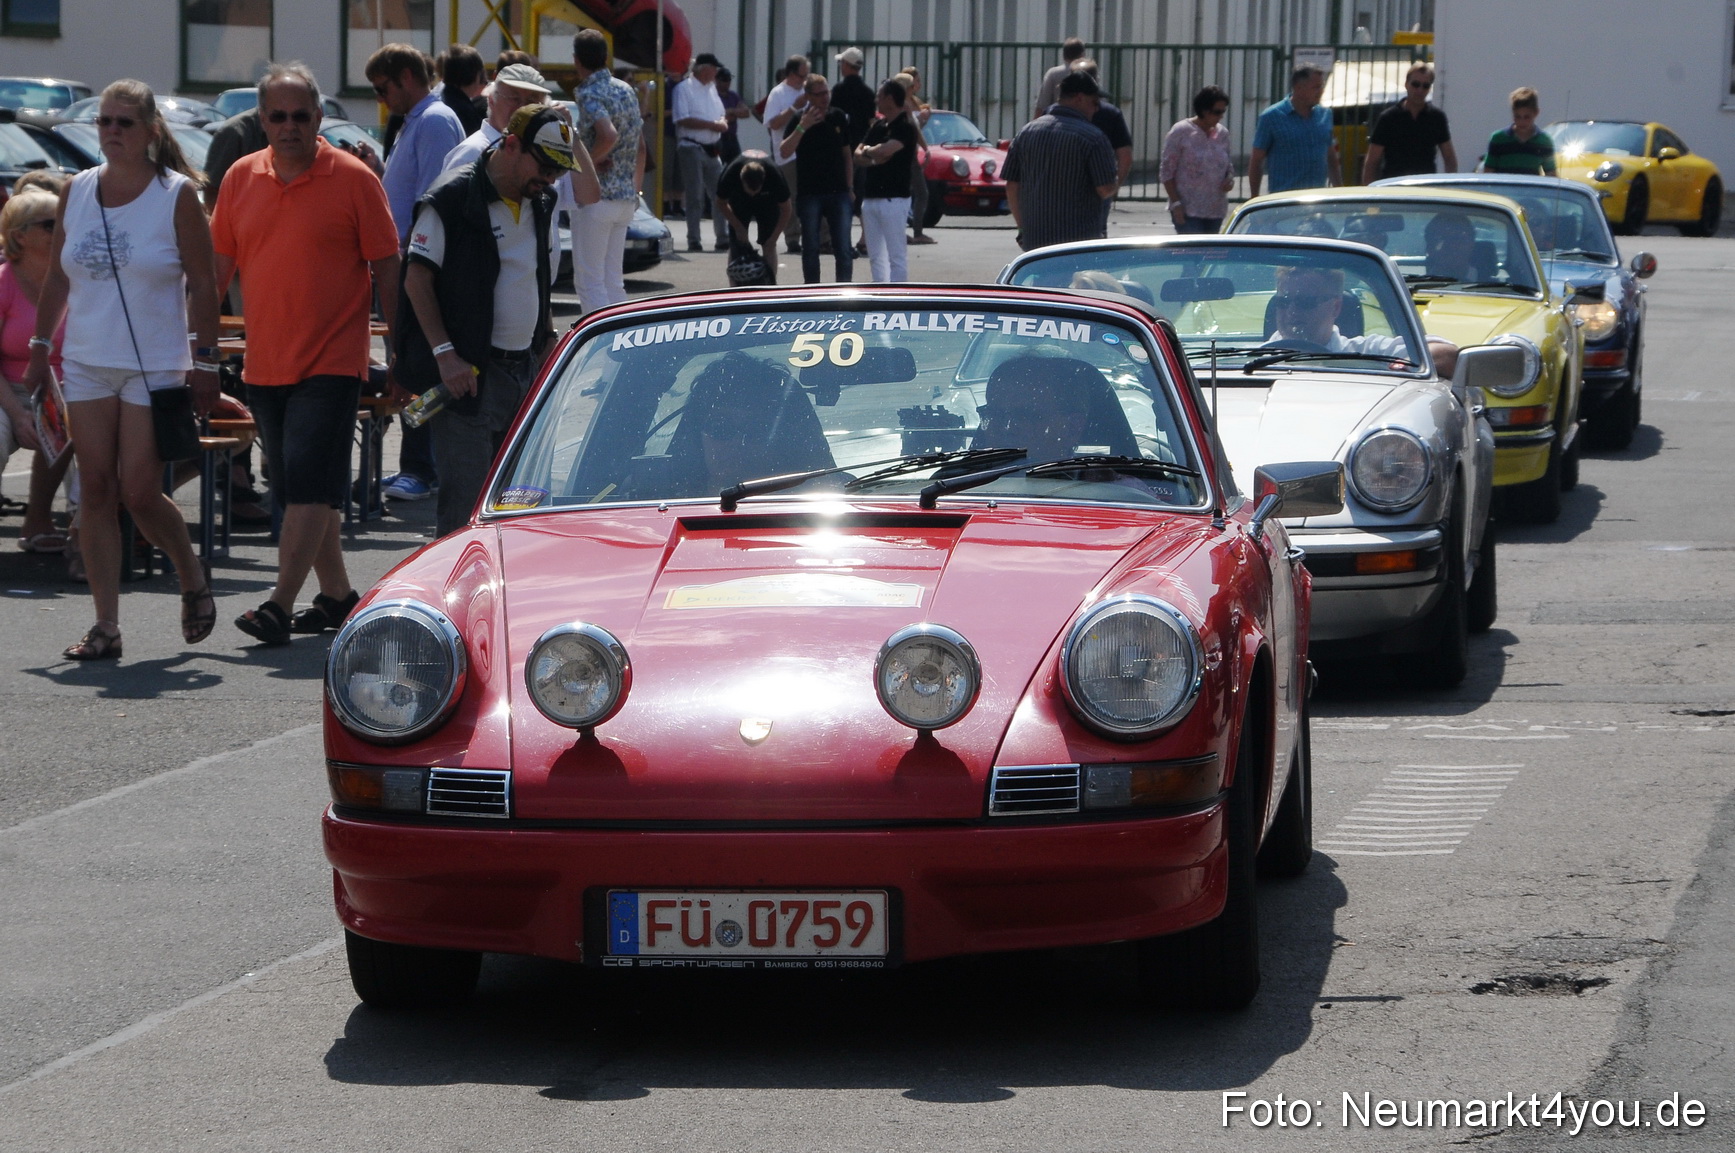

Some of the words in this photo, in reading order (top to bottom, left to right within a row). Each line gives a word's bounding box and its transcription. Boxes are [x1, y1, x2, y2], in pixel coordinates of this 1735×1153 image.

[612, 318, 731, 352] KUMHO
[735, 314, 856, 336] Historic
[863, 313, 1091, 343] RALLYE-TEAM
[788, 332, 865, 368] 50
[620, 930, 630, 943] D
[647, 900, 711, 948] FÜ
[748, 900, 874, 948] 0759
[603, 958, 633, 967] CG
[639, 960, 755, 968] SPORTWAGEN
[814, 960, 884, 968] 0951-9684940
